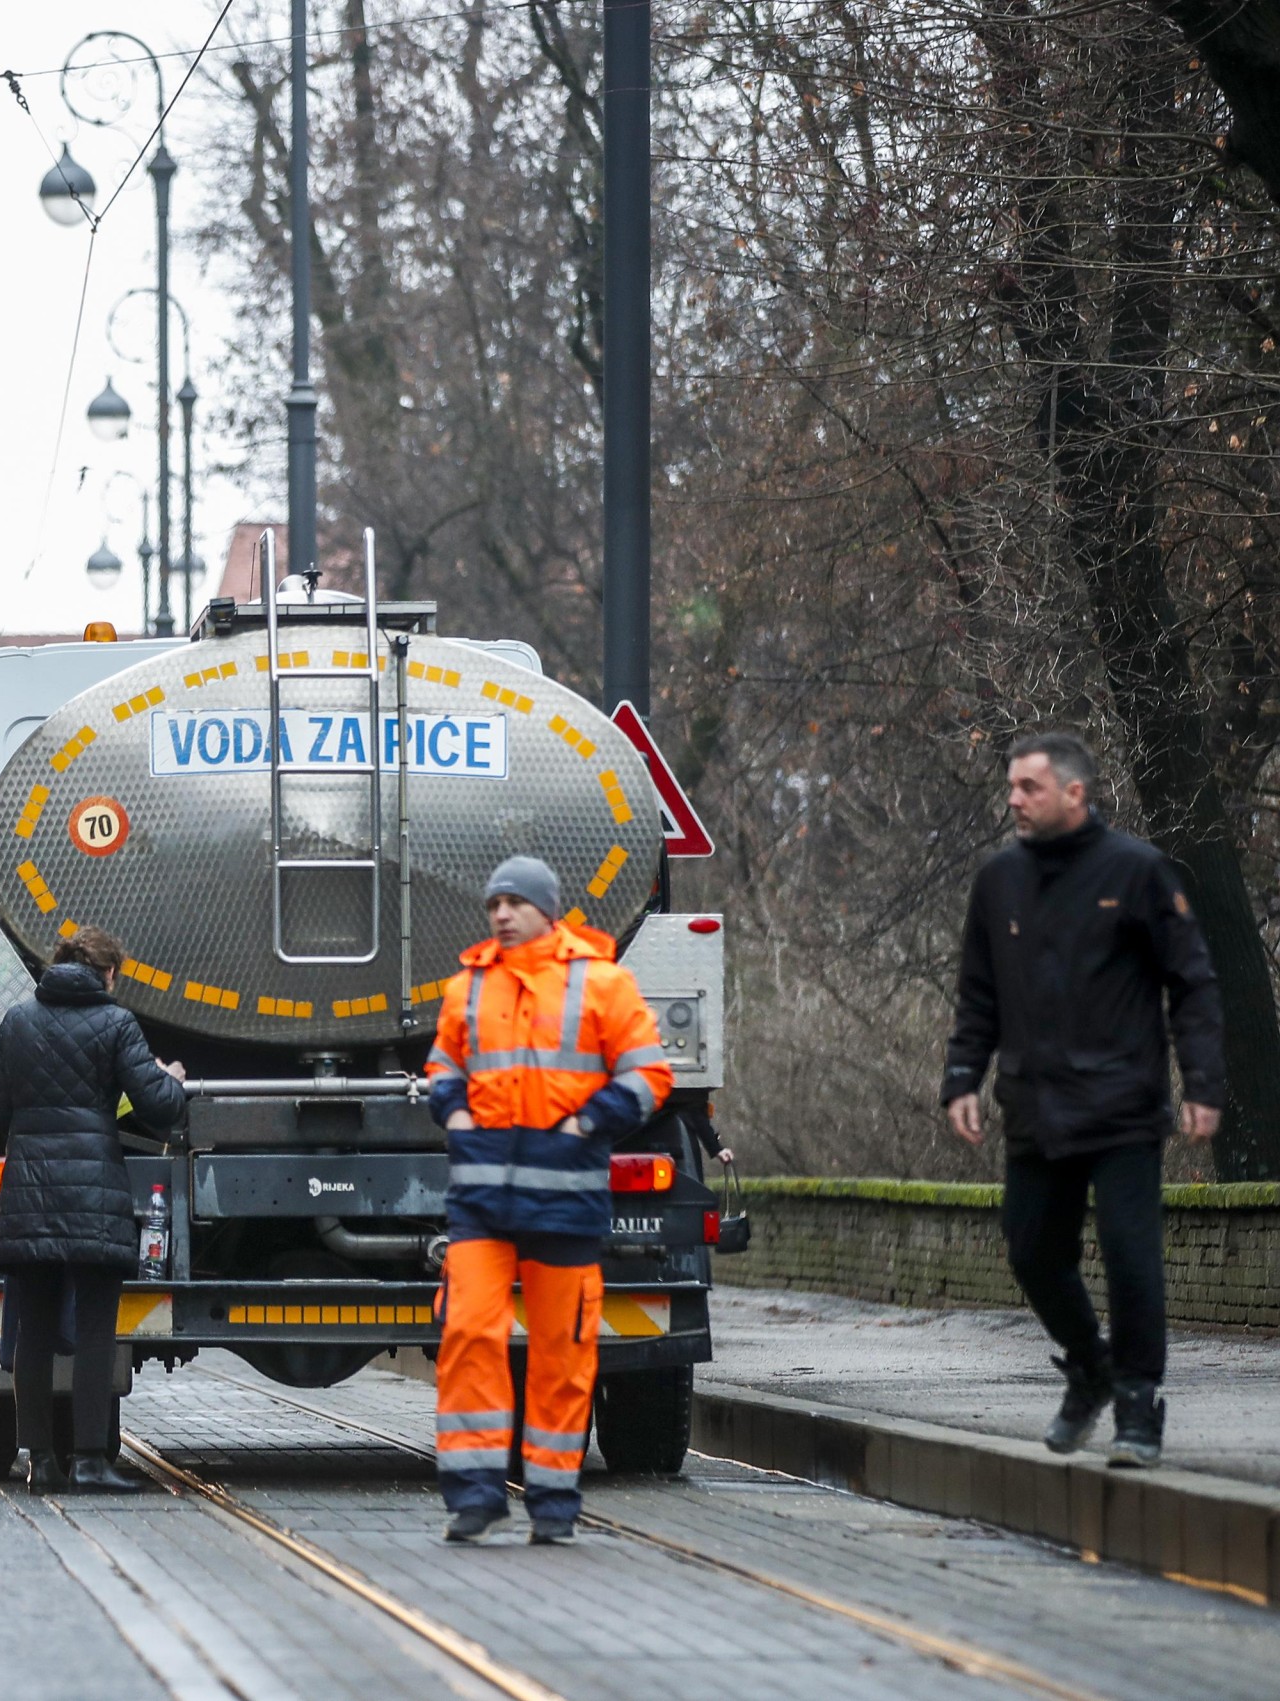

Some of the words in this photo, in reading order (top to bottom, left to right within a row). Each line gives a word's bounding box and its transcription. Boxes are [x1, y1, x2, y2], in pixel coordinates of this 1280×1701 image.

[167, 716, 294, 766] VODA
[307, 716, 367, 764] ZA
[383, 713, 491, 769] PIĆE
[84, 813, 113, 840] 70
[322, 1182, 355, 1192] RIJEKA
[610, 1217, 664, 1234] AULT
